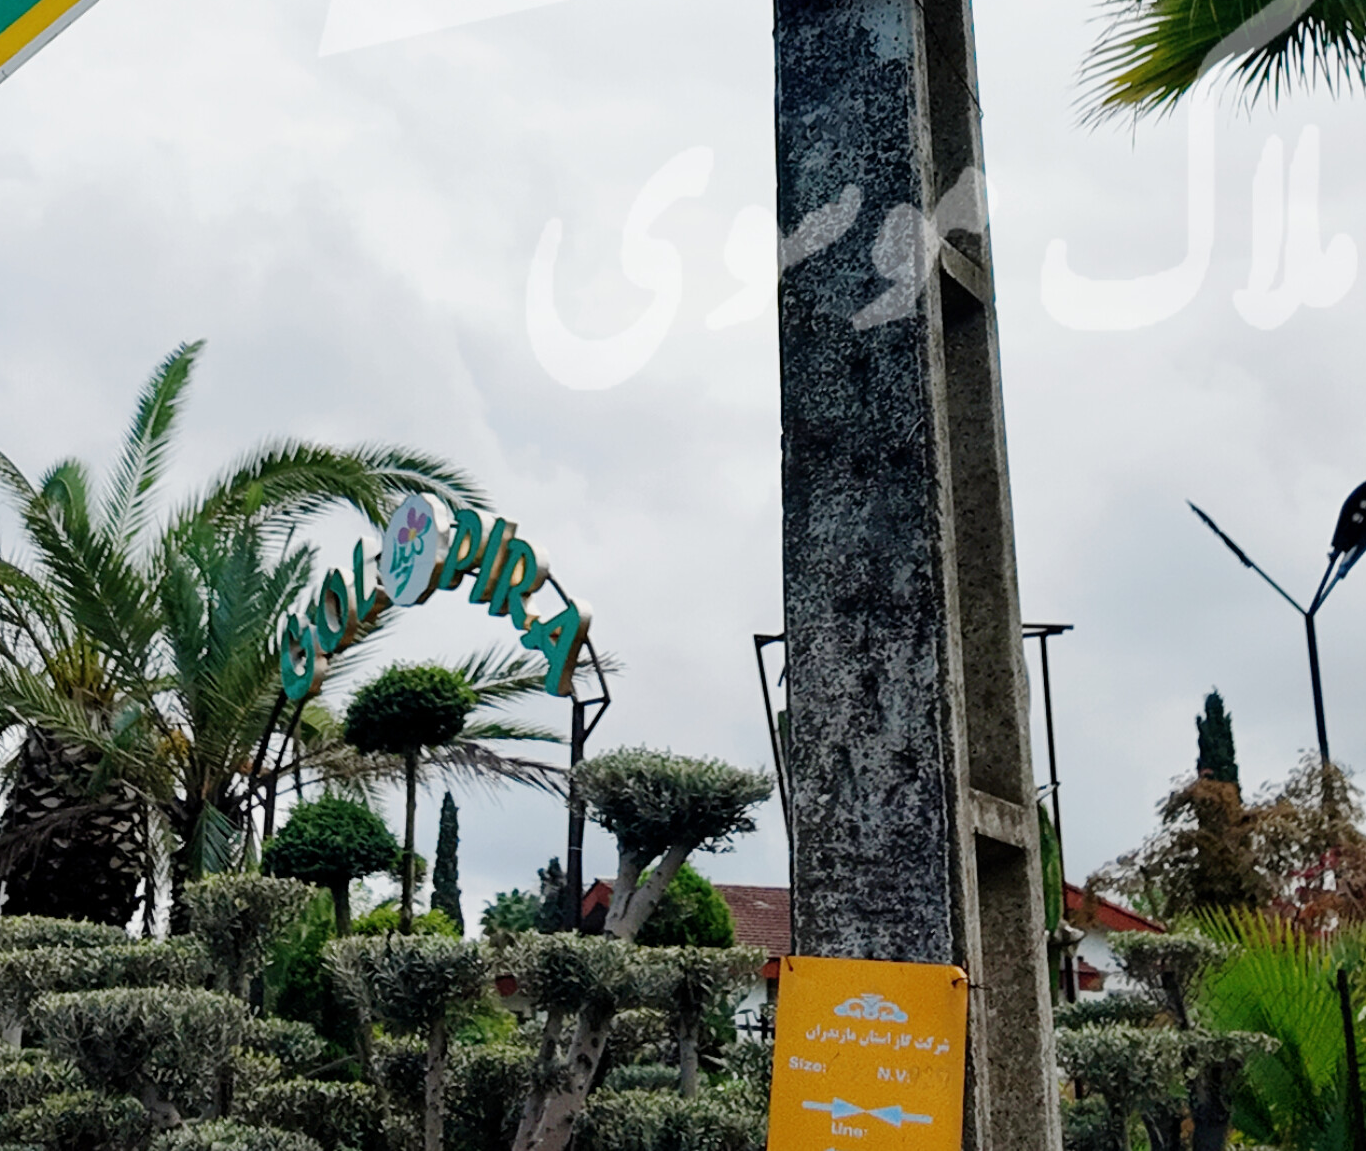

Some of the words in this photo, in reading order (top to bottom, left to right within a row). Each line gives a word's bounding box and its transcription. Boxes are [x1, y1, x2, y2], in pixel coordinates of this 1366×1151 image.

[280, 536, 381, 700] GOL
[434, 508, 583, 698] PIRA
[805, 1024, 857, 1044] مازندران
[859, 1030, 892, 1046] استان
[894, 1033, 912, 1050] گاز
[914, 1036, 950, 1055] شرکت
[788, 1056, 826, 1074] Size:
